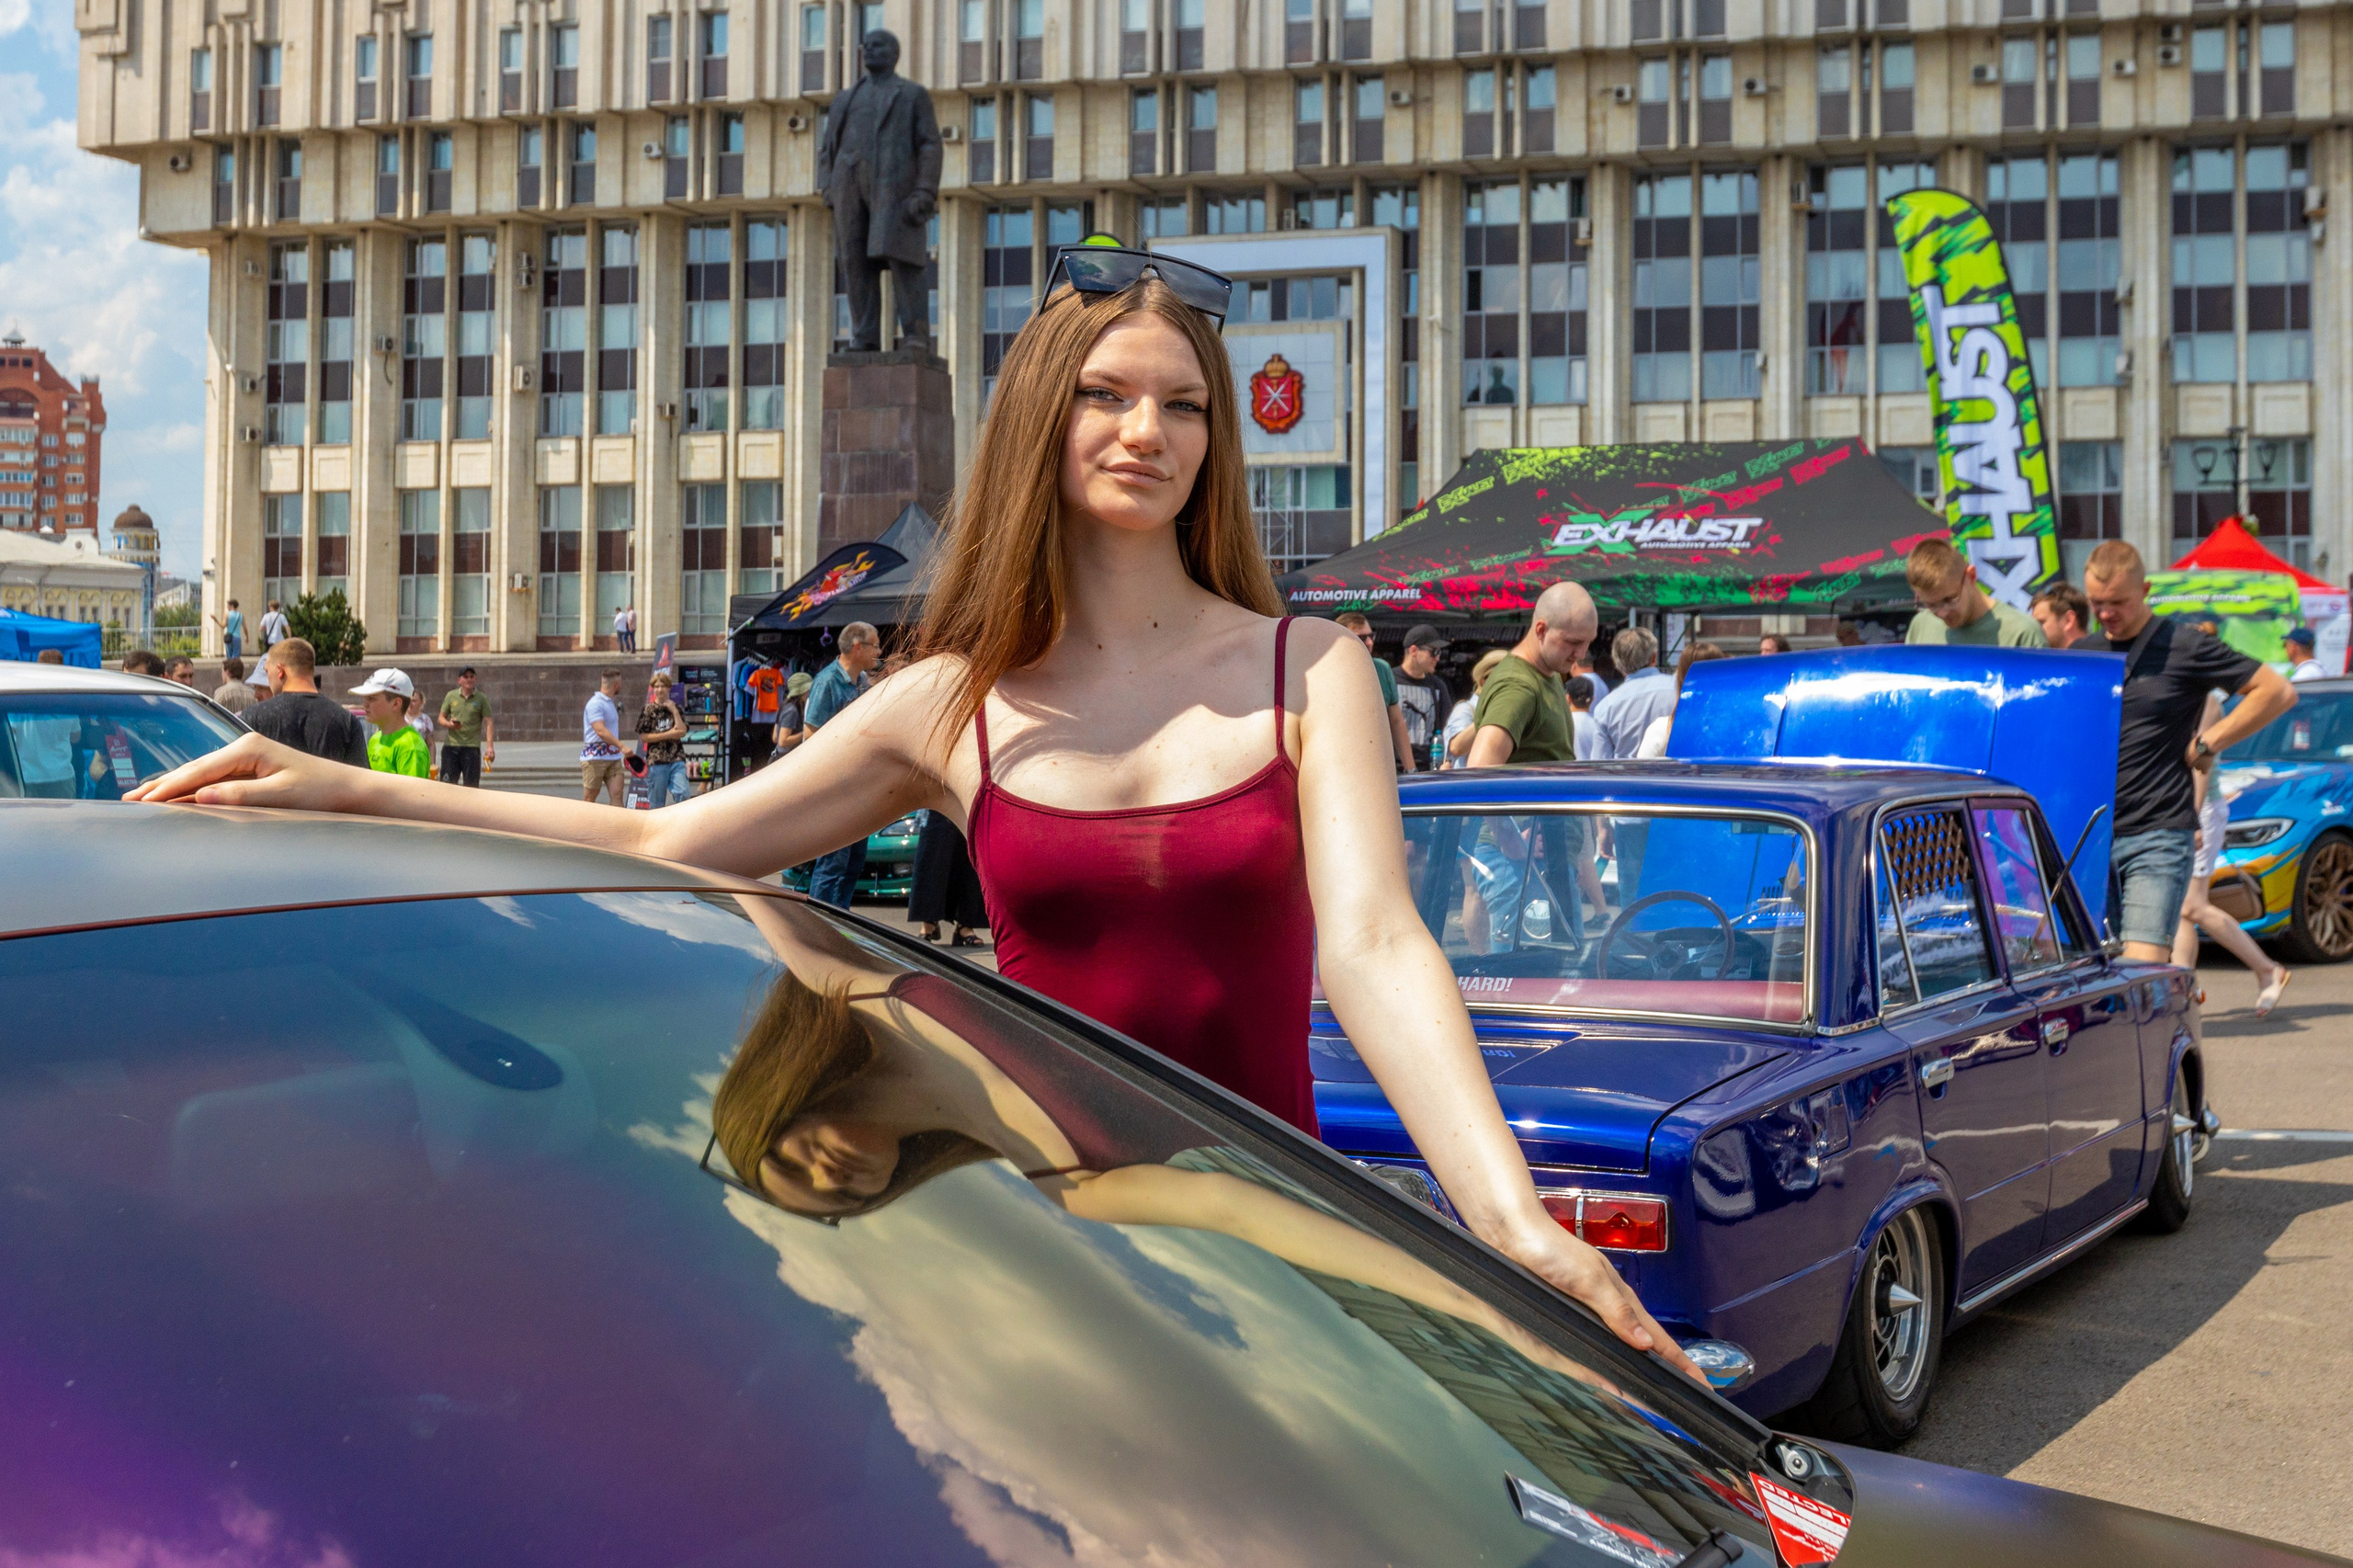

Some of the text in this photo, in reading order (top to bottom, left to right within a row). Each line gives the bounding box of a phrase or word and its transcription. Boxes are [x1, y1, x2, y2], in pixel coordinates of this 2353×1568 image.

[1921, 285, 2042, 614] XHAUST
[1550, 511, 1763, 551] EXHAUST
[1639, 541, 1705, 550] AUTOMOTIVE
[1290, 588, 1422, 602] AUTOMOTIVE APPAREL
[1458, 976, 1513, 992] HARD!
[1757, 1478, 1851, 1528] LECTED
